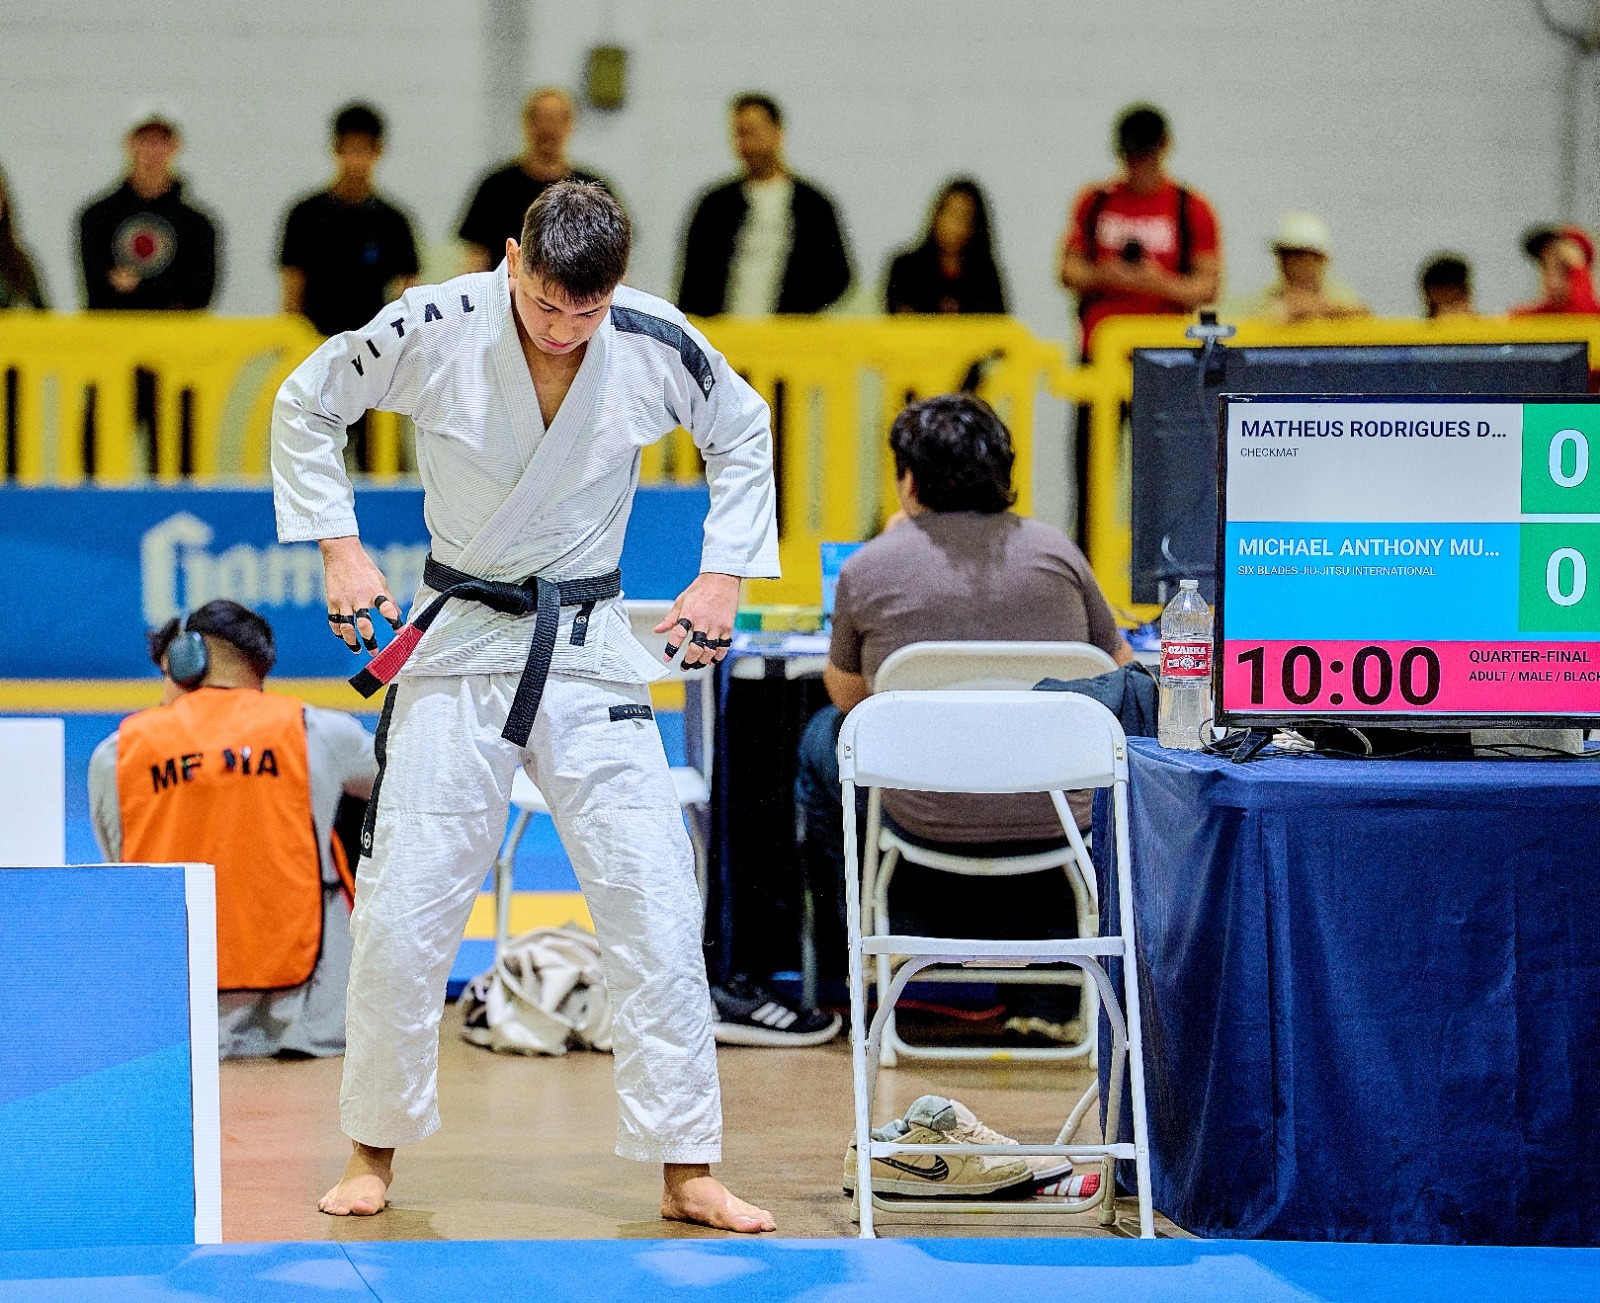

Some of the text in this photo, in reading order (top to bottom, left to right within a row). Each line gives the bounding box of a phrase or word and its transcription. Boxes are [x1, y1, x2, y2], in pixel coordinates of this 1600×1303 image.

[351, 294, 475, 377] VITAL
[1241, 420, 1344, 438] MATHEUS
[1350, 420, 1471, 438] RODRIGUES
[1240, 447, 1300, 458] CHECKMAT
[1548, 428, 1590, 489] 0
[1238, 538, 1500, 557] MICHAEL ANTHONY MU...
[1237, 565, 1437, 577] SIX BLADES JIU-JITSU INTERNATIONAL
[1545, 546, 1588, 608] 0
[1469, 650, 1591, 664] QUARTER-FINAL
[1236, 645, 1441, 706] 10:00
[1469, 671, 1508, 682] ADULT
[1518, 671, 1553, 682] MALE
